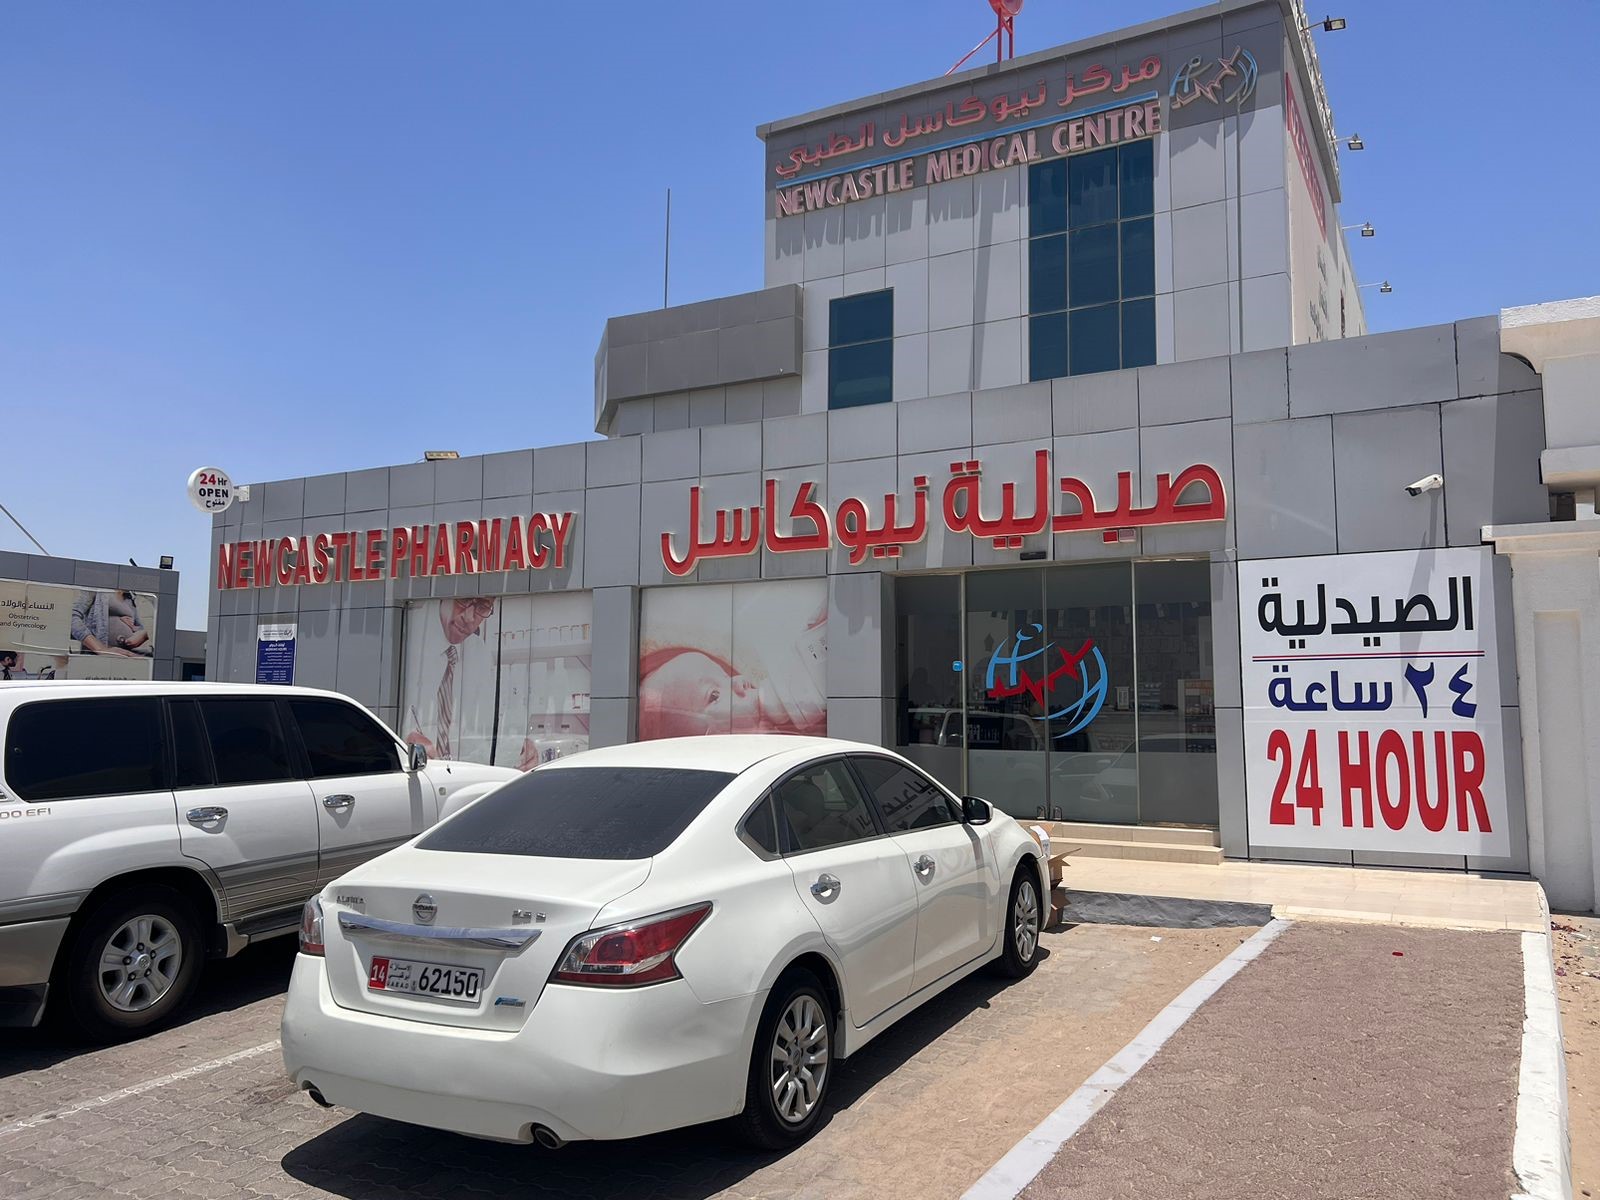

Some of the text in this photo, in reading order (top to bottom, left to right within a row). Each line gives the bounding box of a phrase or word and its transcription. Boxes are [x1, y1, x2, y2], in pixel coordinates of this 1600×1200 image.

[775, 54, 1162, 179] مركز نيوكاسل الطبي
[775, 100, 1162, 218] NEWCASTLE MEDICAL CENTRE
[199, 488, 229, 498] OPEN
[200, 473, 228, 486] 24 Hr
[206, 499, 226, 508] مفتوح
[660, 449, 1227, 577] صيدلية نيوكاسل
[217, 511, 576, 590] NEWCASTLE PHARMACY
[8, 612, 40, 621] Obstetrics
[28, 602, 55, 611] النساء
[1257, 575, 1475, 650] الصيدلية
[13, 621, 48, 630] Gynecology
[1267, 664, 1393, 712] ساعة
[1266, 728, 1493, 833] 24 HOUR
[26, 807, 51, 816] EFI
[372, 965, 385, 982] 14
[418, 967, 479, 998] 62150
